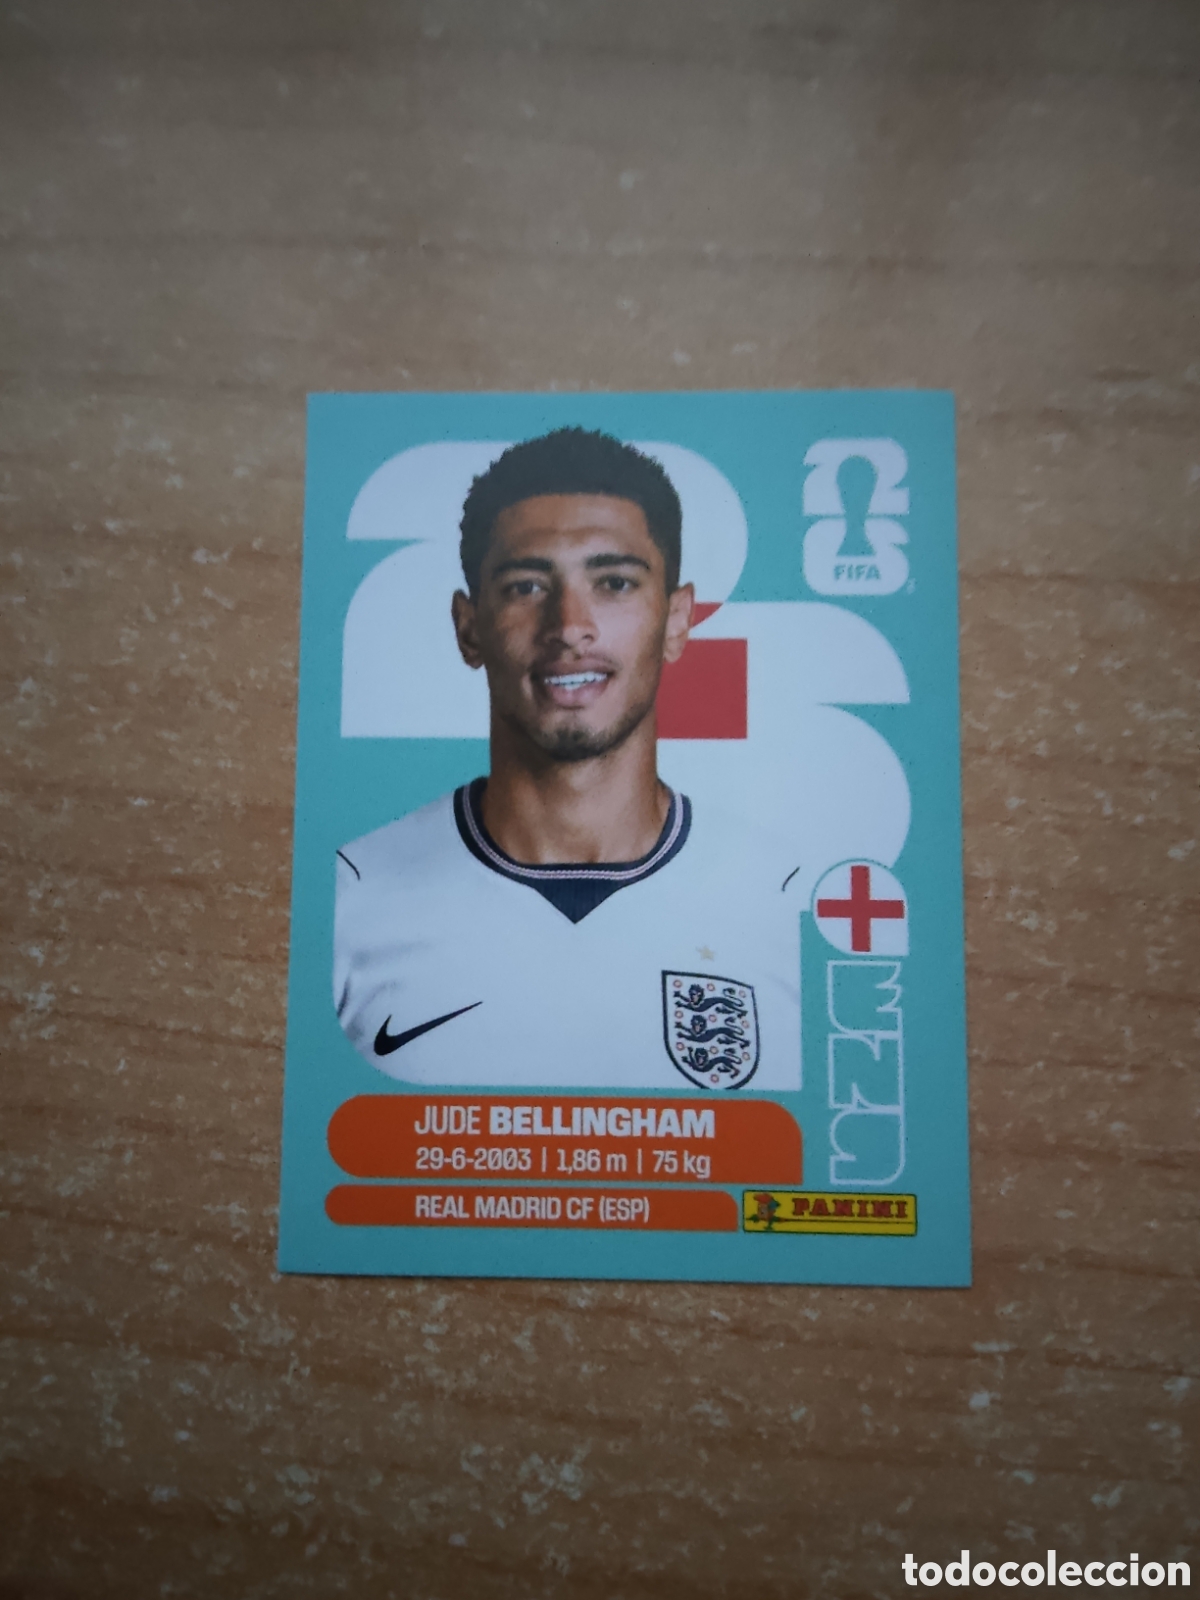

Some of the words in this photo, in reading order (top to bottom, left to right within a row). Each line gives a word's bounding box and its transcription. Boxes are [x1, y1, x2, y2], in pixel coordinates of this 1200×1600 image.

[833, 564, 881, 581] FIFA
[414, 1105, 482, 1135] JUDE
[489, 1106, 715, 1139] BELLINGHAM
[415, 1147, 532, 1171] 29-6-2003
[556, 1149, 601, 1175] 1,86
[606, 1153, 627, 1173] m
[652, 1150, 678, 1174] 75
[683, 1150, 711, 1179] kg
[415, 1195, 470, 1219] REAL
[474, 1196, 561, 1220] MADRID
[566, 1197, 594, 1221] CF
[599, 1195, 650, 1223] (ESP)
[791, 1197, 908, 1219] PANINI
